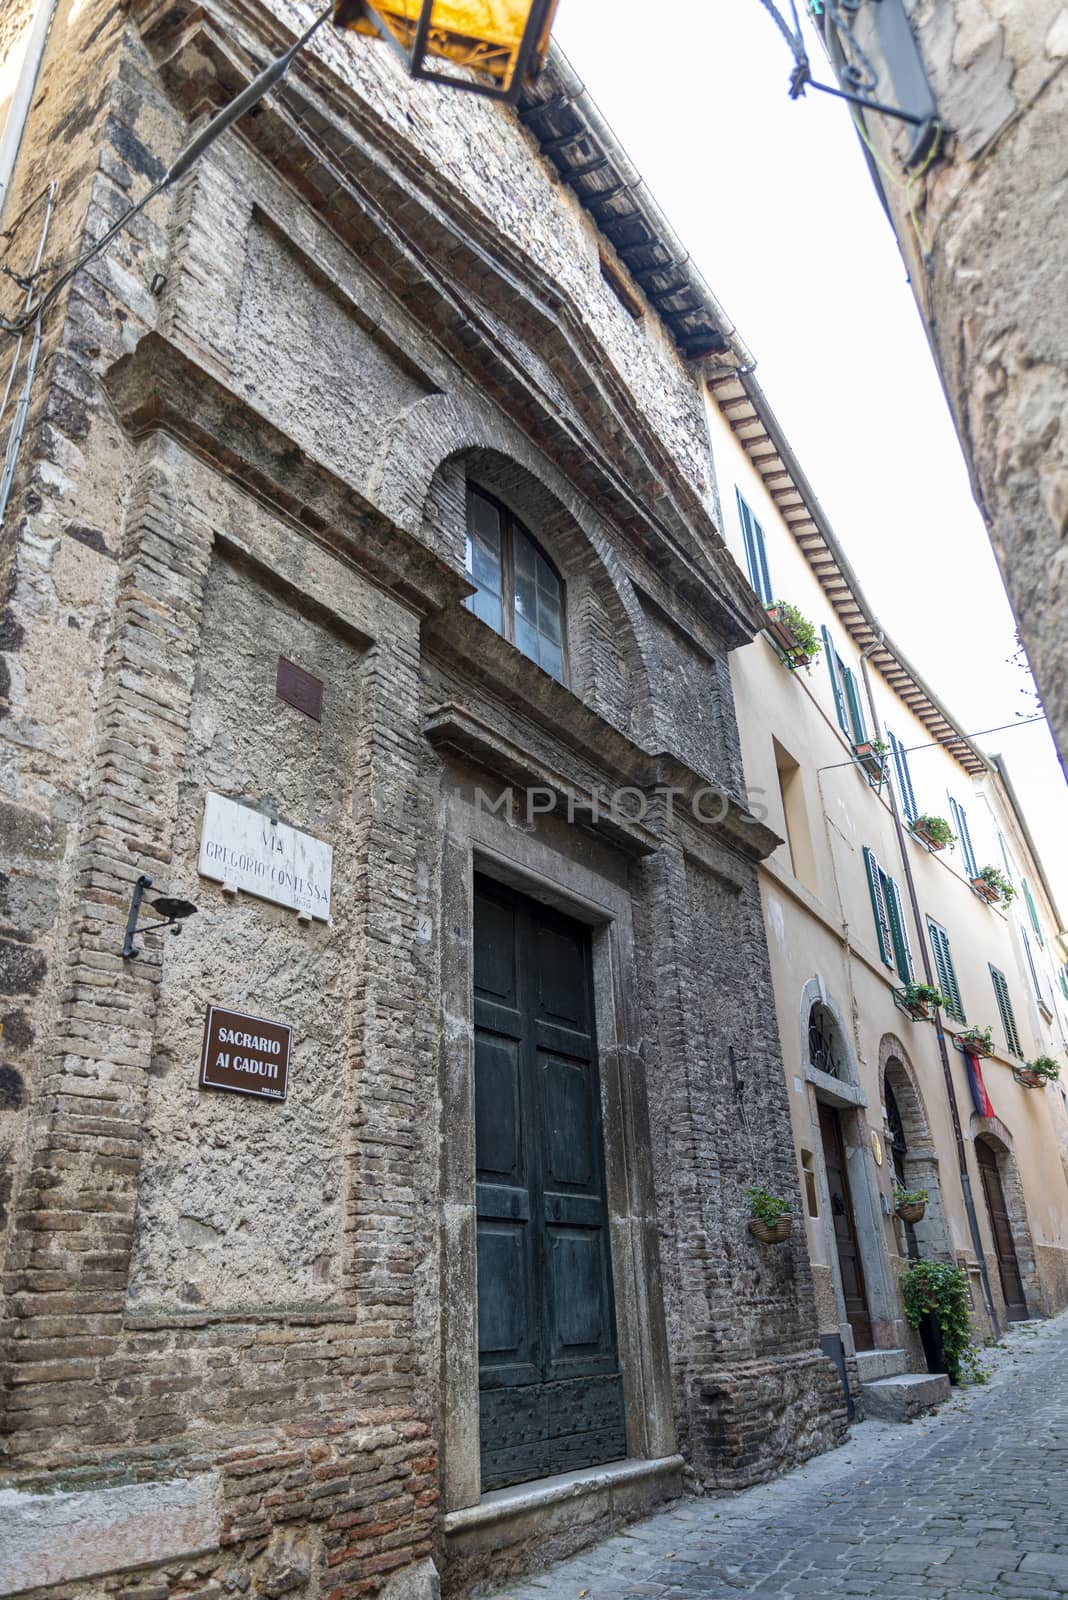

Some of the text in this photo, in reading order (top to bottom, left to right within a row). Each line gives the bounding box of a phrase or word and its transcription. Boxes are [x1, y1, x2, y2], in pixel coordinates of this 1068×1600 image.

[262, 831, 284, 855] VIA
[206, 840, 265, 877] GREGORIO
[218, 1027, 281, 1055] SACRARIO
[216, 1052, 279, 1079] AI CADUTI
